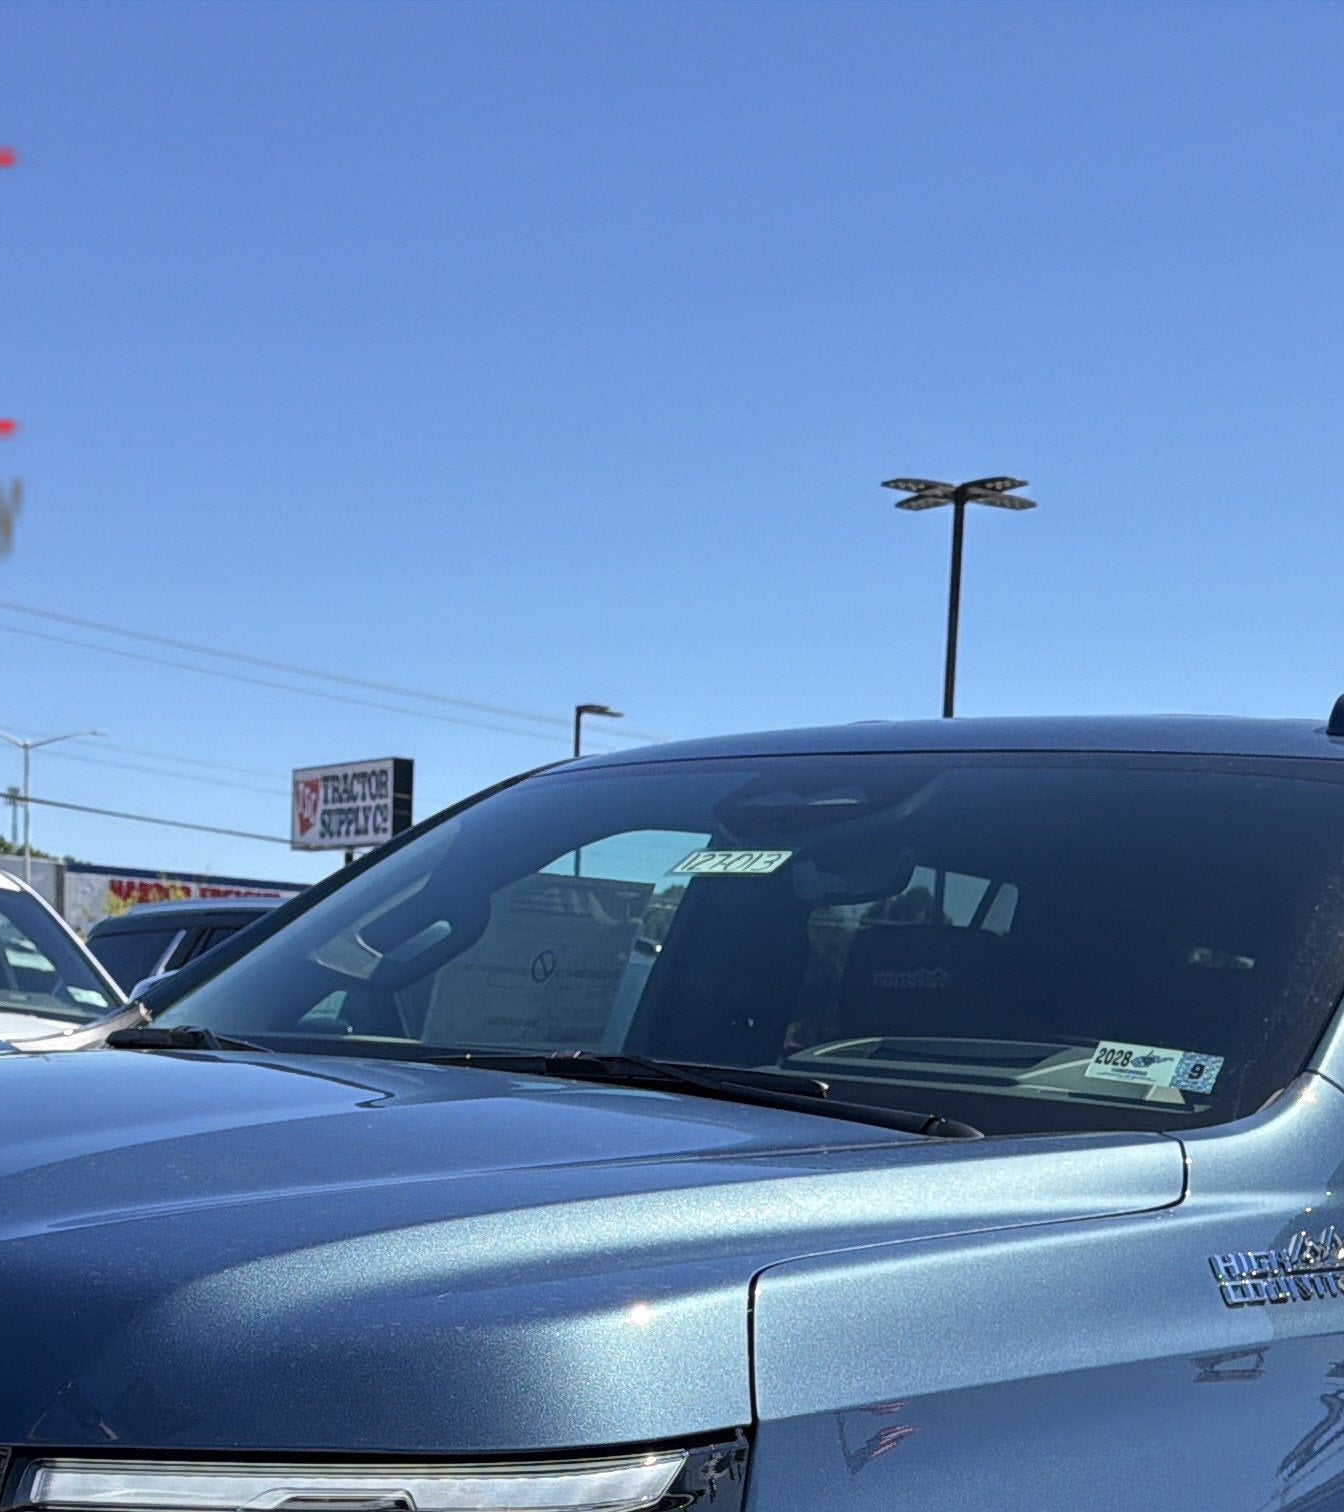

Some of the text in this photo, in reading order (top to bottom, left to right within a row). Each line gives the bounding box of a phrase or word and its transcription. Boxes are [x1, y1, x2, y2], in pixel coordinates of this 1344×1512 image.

[1094, 1047, 1133, 1067] 2028
[1188, 1063, 1205, 1080] 9
[1208, 1249, 1294, 1282] HIGH
